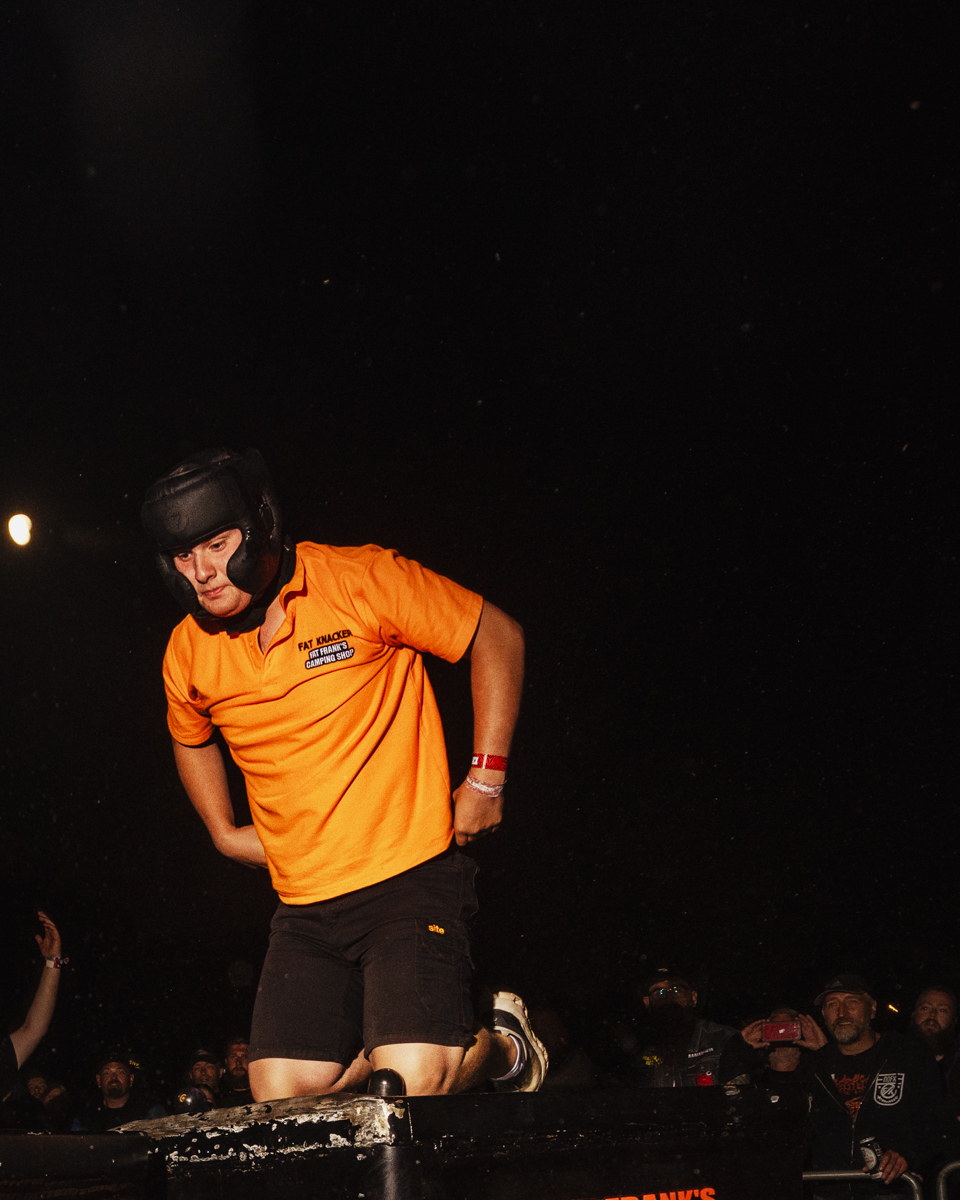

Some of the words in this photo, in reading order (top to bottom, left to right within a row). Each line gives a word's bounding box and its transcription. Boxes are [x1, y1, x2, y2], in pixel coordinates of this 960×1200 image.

[298, 639, 313, 651] FAT
[316, 629, 352, 646] KNACKER
[305, 654, 336, 669] CAMPING
[336, 648, 354, 661] SHOP
[309, 649, 320, 659] FAT
[320, 641, 348, 656] FRANK'S
[428, 924, 445, 934] site
